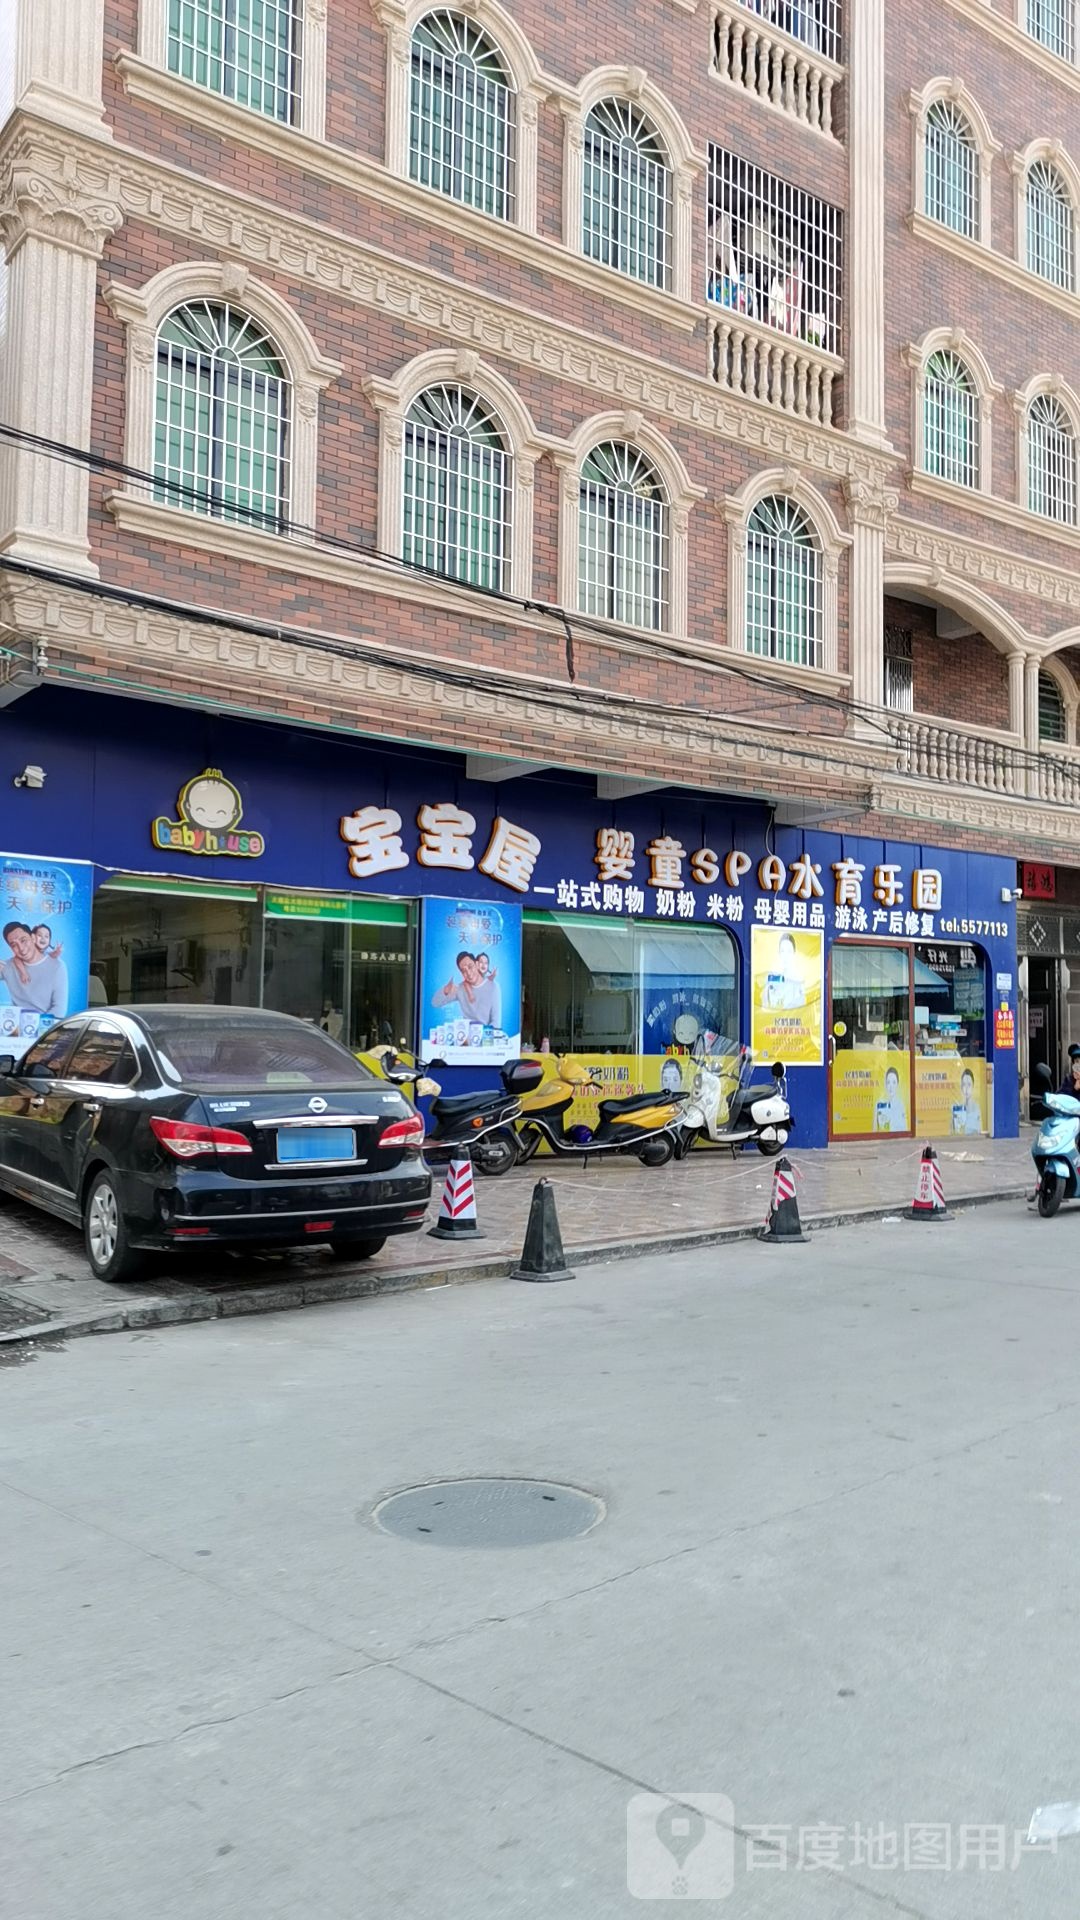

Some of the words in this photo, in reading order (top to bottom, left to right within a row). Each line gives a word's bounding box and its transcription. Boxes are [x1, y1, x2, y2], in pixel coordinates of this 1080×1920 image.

[340, 803, 541, 893] 宝宝屋
[534, 879, 645, 913] 一站式购物
[656, 888, 696, 918] 奶粉
[707, 893, 744, 921] 米粉
[754, 898, 825, 928] 母婴用品
[835, 905, 868, 932] 游泳
[872, 908, 935, 937] 产后修复
